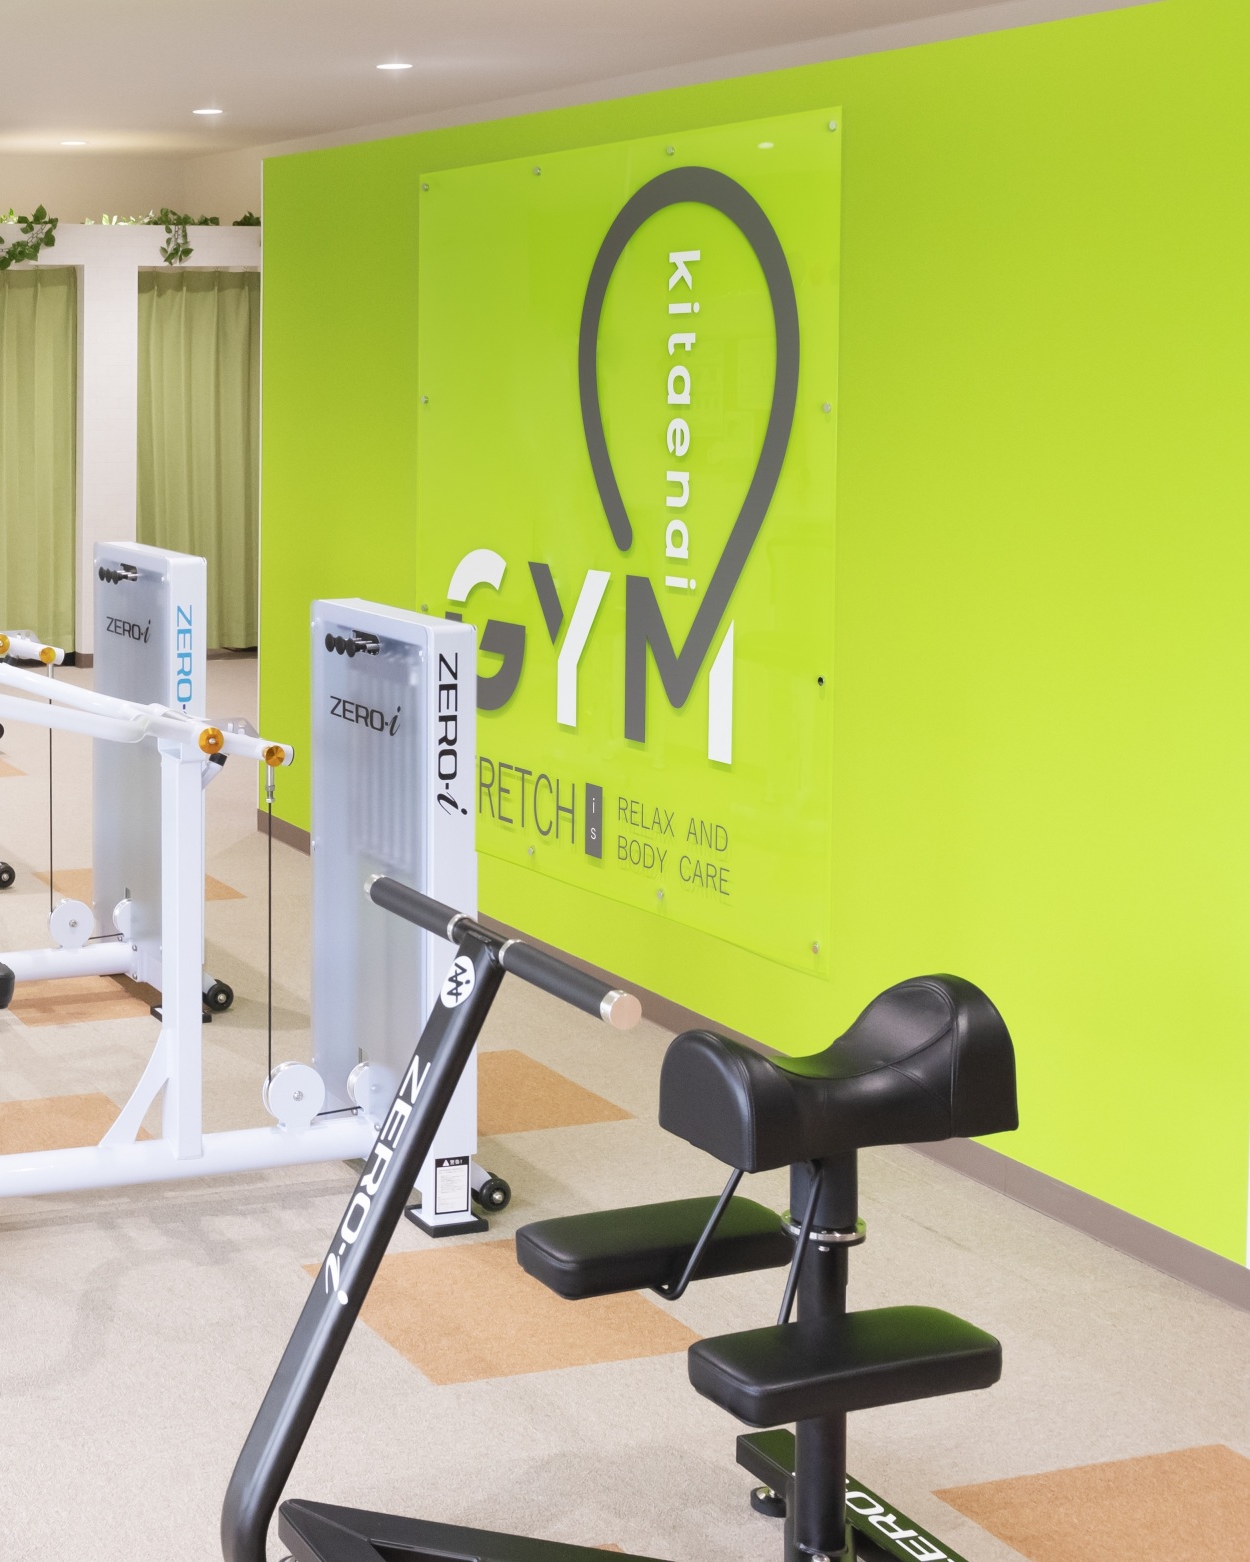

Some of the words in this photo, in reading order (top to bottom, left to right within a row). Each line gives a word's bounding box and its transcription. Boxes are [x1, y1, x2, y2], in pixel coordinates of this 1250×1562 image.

[665, 249, 701, 591] kitaenai
[176, 604, 193, 715] ZERO-
[445, 548, 735, 765] GYM
[475, 755, 575, 845] RETCH
[618, 796, 675, 838] RELAX
[686, 817, 729, 852] AND
[617, 834, 668, 874] BODY
[679, 855, 730, 896] CARE
